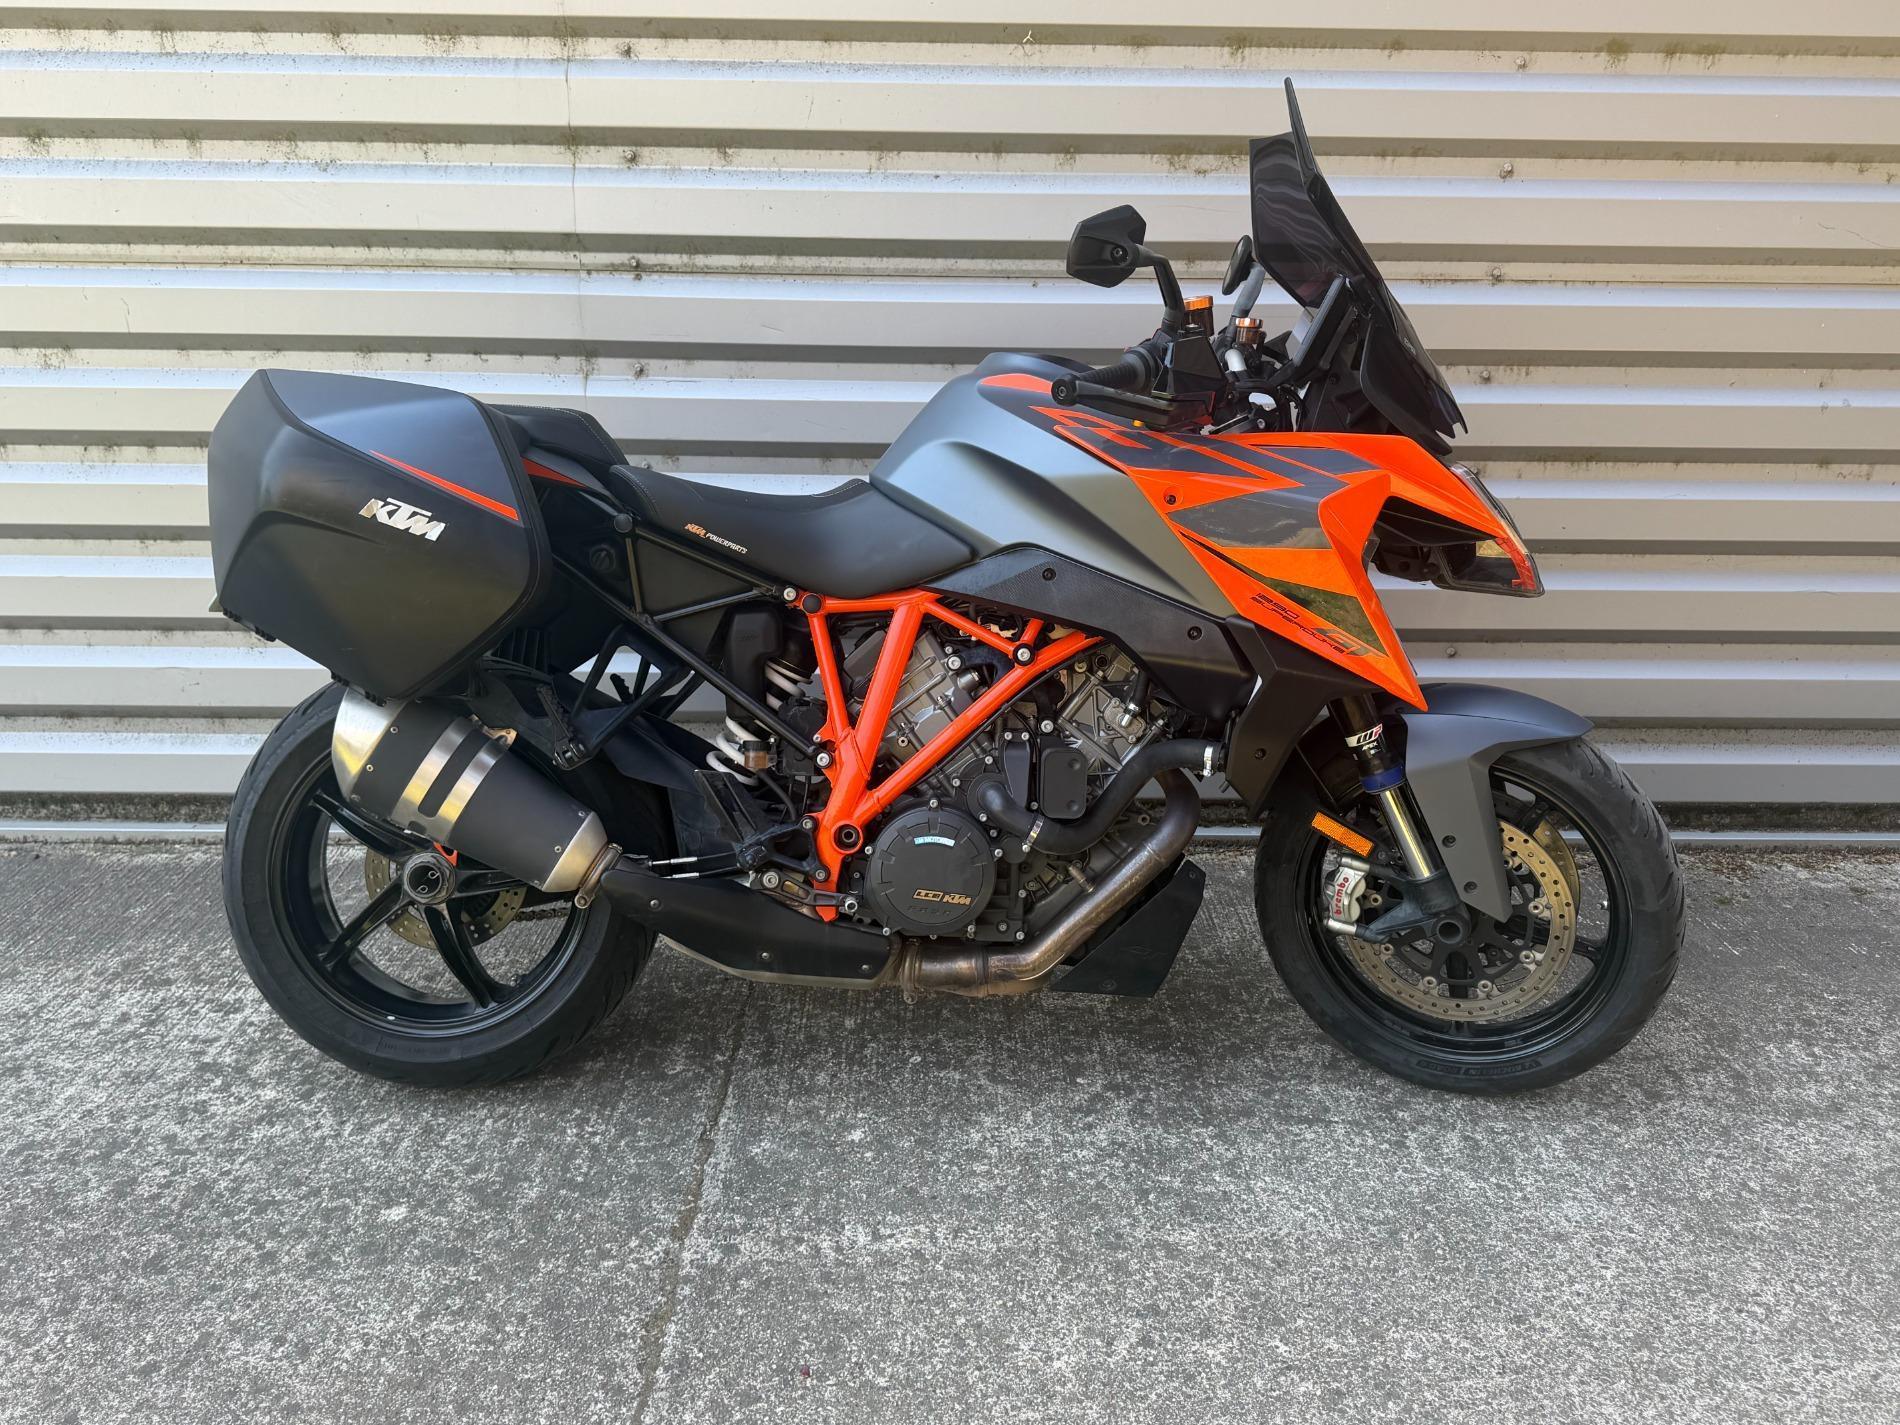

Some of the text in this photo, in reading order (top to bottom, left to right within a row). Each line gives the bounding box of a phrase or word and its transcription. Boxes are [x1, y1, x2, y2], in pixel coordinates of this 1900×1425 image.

[358, 497, 446, 542] KTM
[684, 523, 748, 554] KTM POWERPARTS
[1356, 725, 1382, 744] WP
[943, 893, 972, 906] KTM
[1333, 876, 1350, 916] brembo
